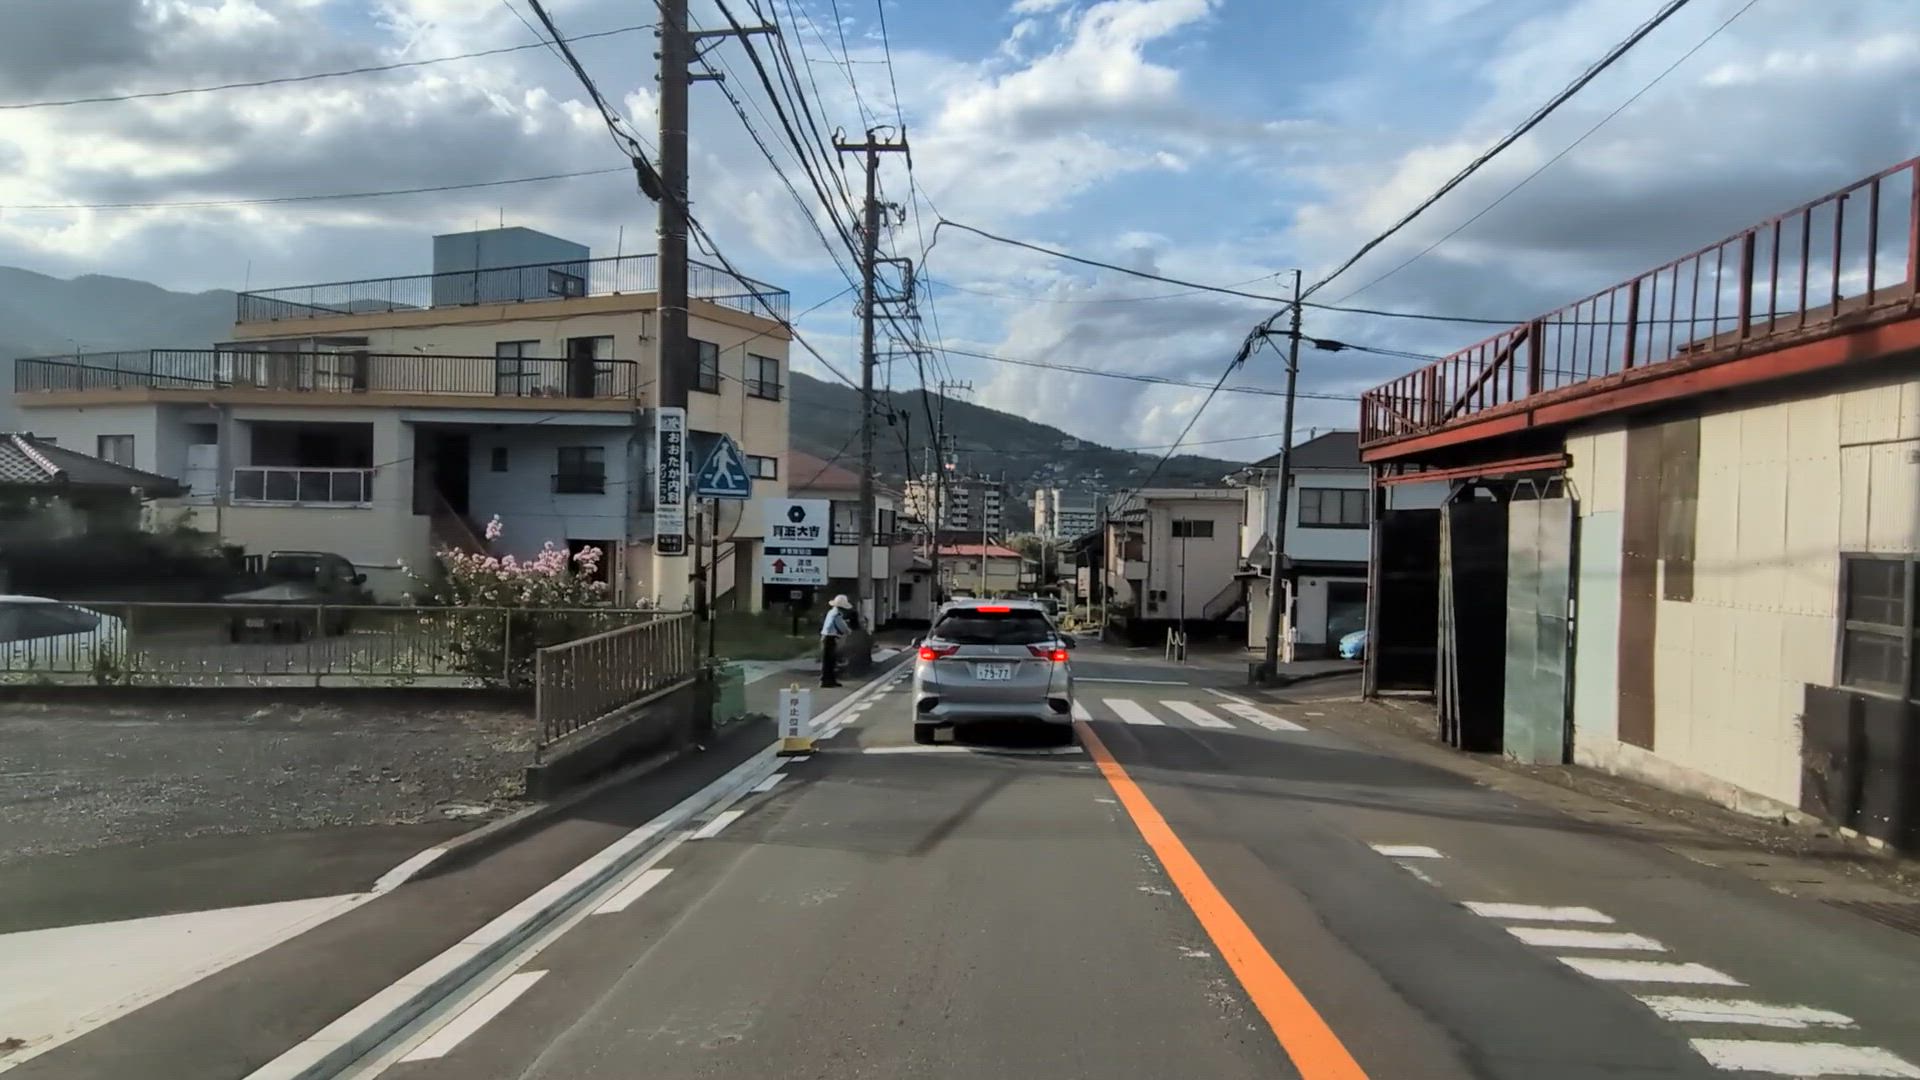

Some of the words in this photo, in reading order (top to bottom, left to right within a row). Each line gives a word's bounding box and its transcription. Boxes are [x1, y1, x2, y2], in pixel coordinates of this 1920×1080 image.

[668, 432, 680, 504] おおたか内科
[773, 525, 821, 538] 買取大吉
